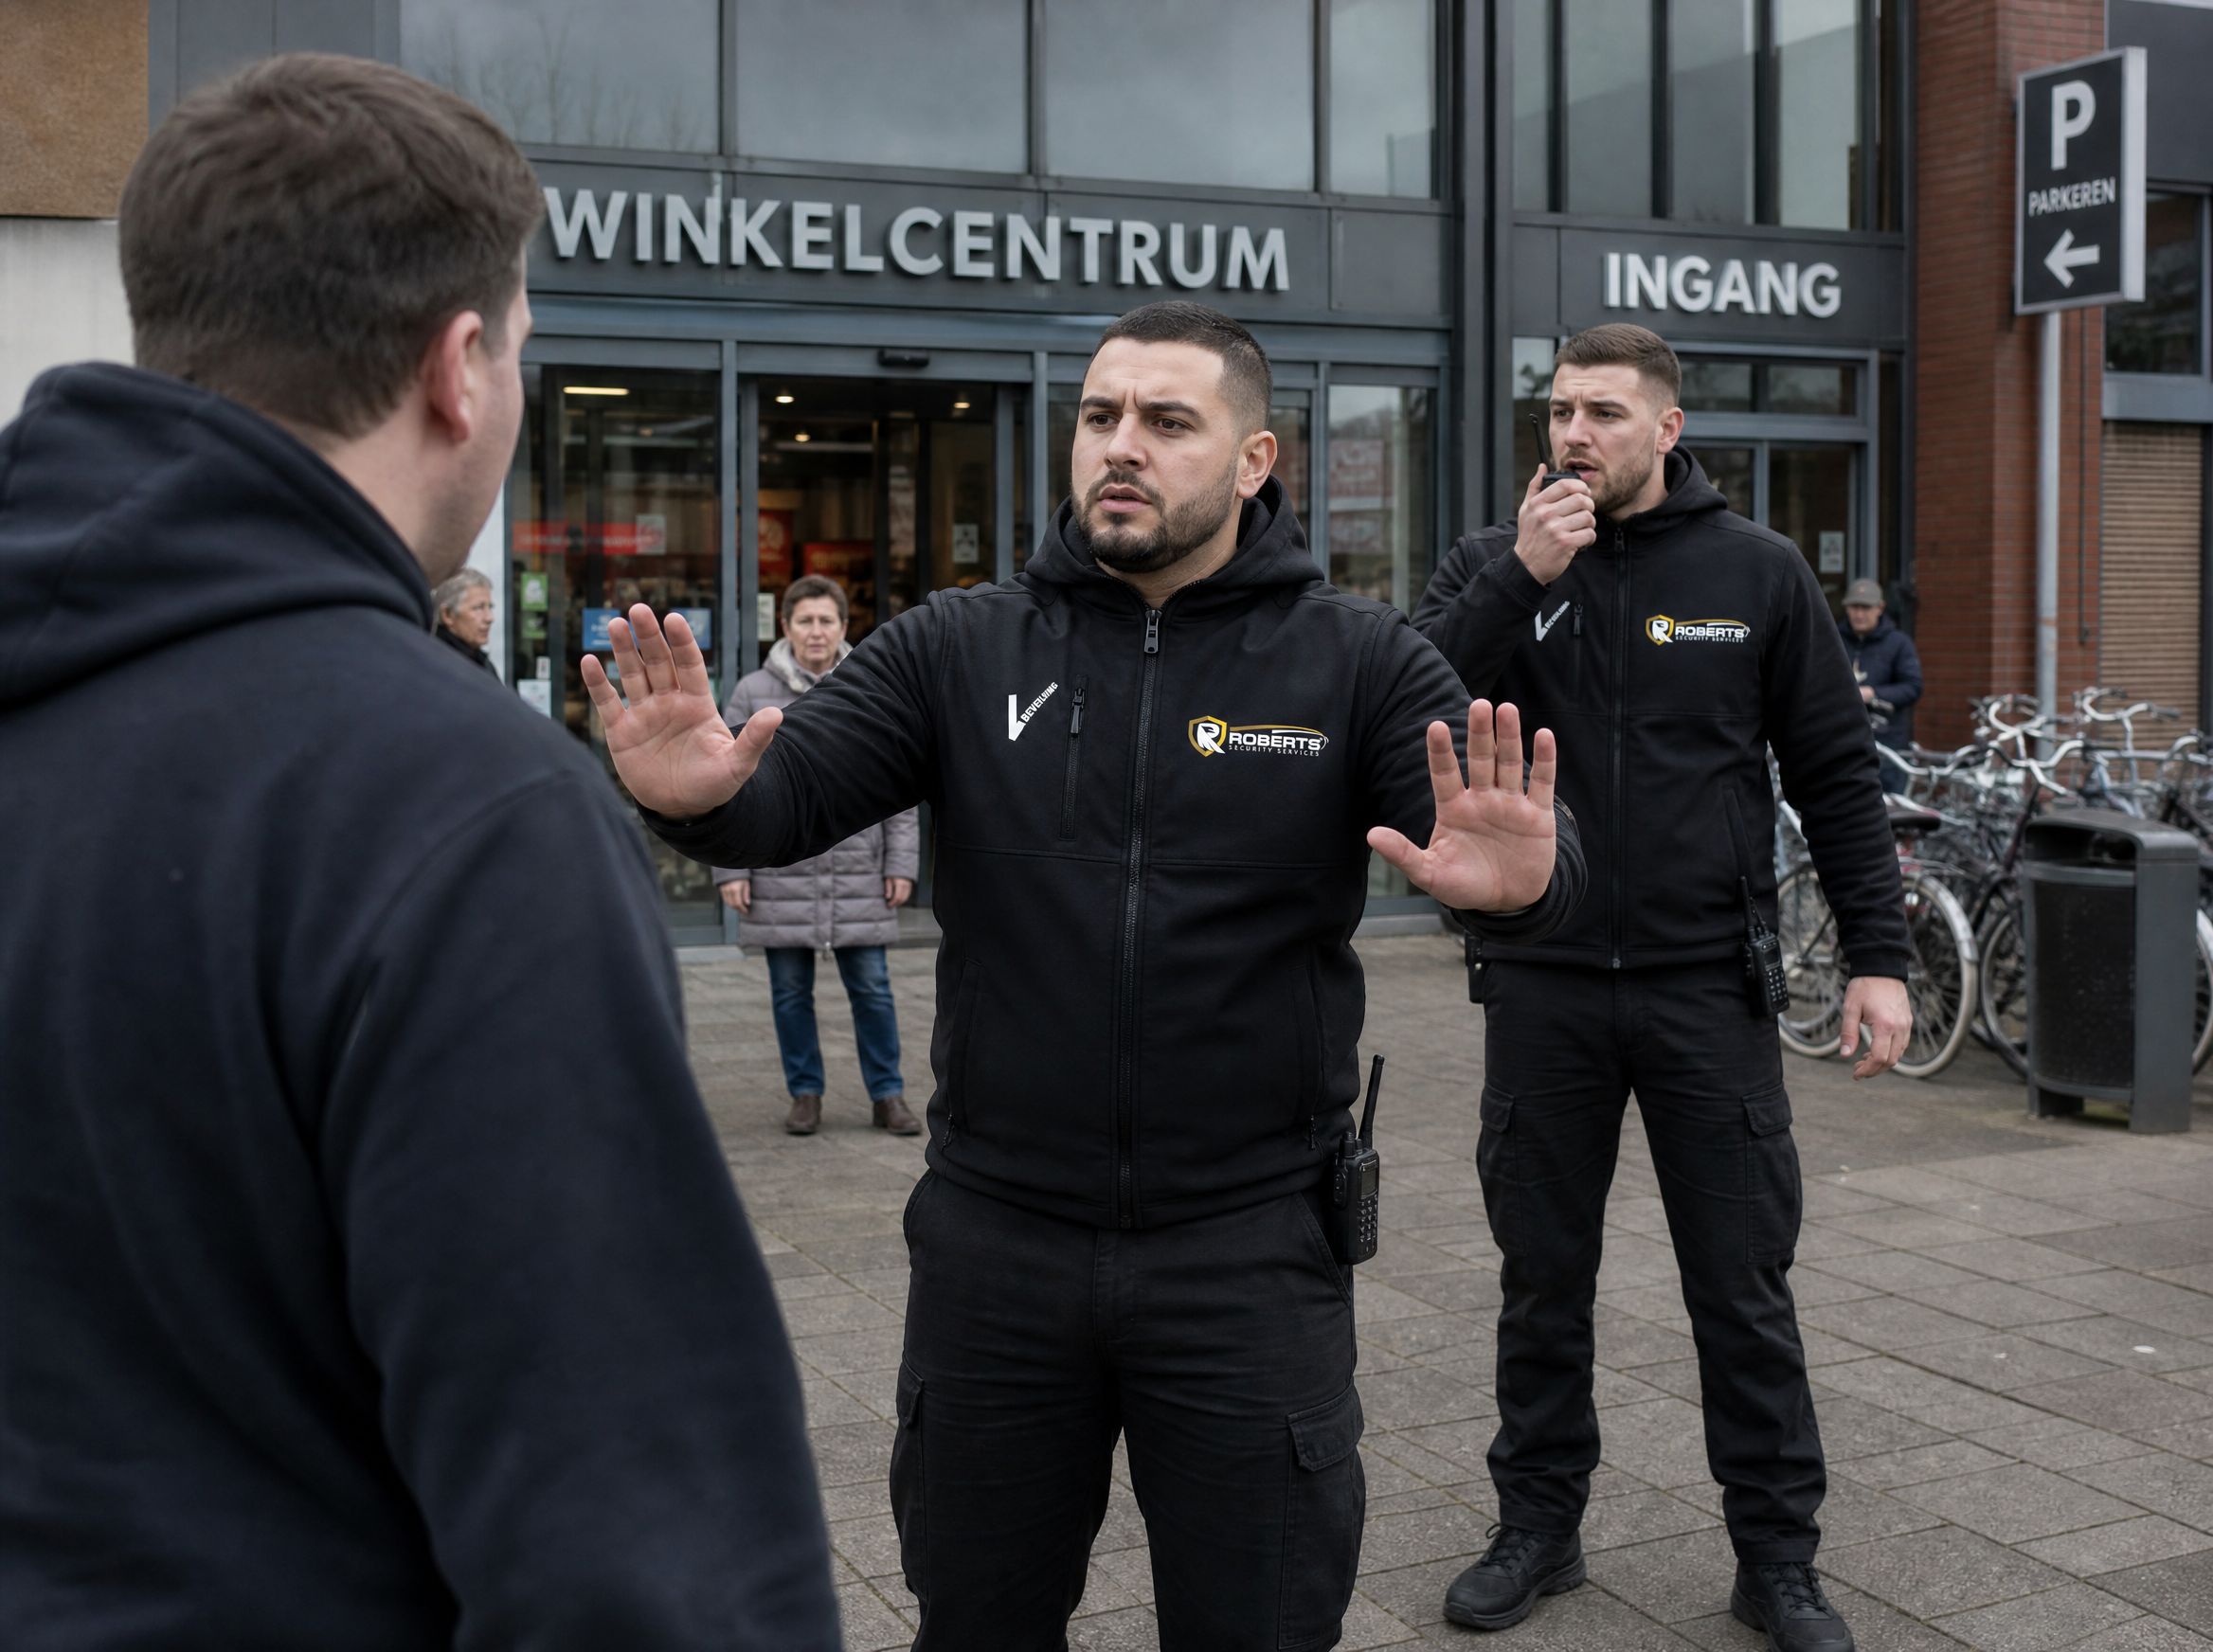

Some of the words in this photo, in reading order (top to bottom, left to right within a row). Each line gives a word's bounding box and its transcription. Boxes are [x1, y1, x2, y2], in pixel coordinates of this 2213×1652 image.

[2051, 80, 2096, 171] P
[2028, 176, 2116, 217] PARKEREN
[543, 187, 1289, 291] WINKELCENTRUM
[1604, 252, 1842, 318] INGANG
[1675, 626, 1744, 638] ROBERTS
[1229, 732, 1321, 751] ROBERTS
[1229, 745, 1273, 754] SECURITY
[1277, 747, 1320, 757] SERVICES
